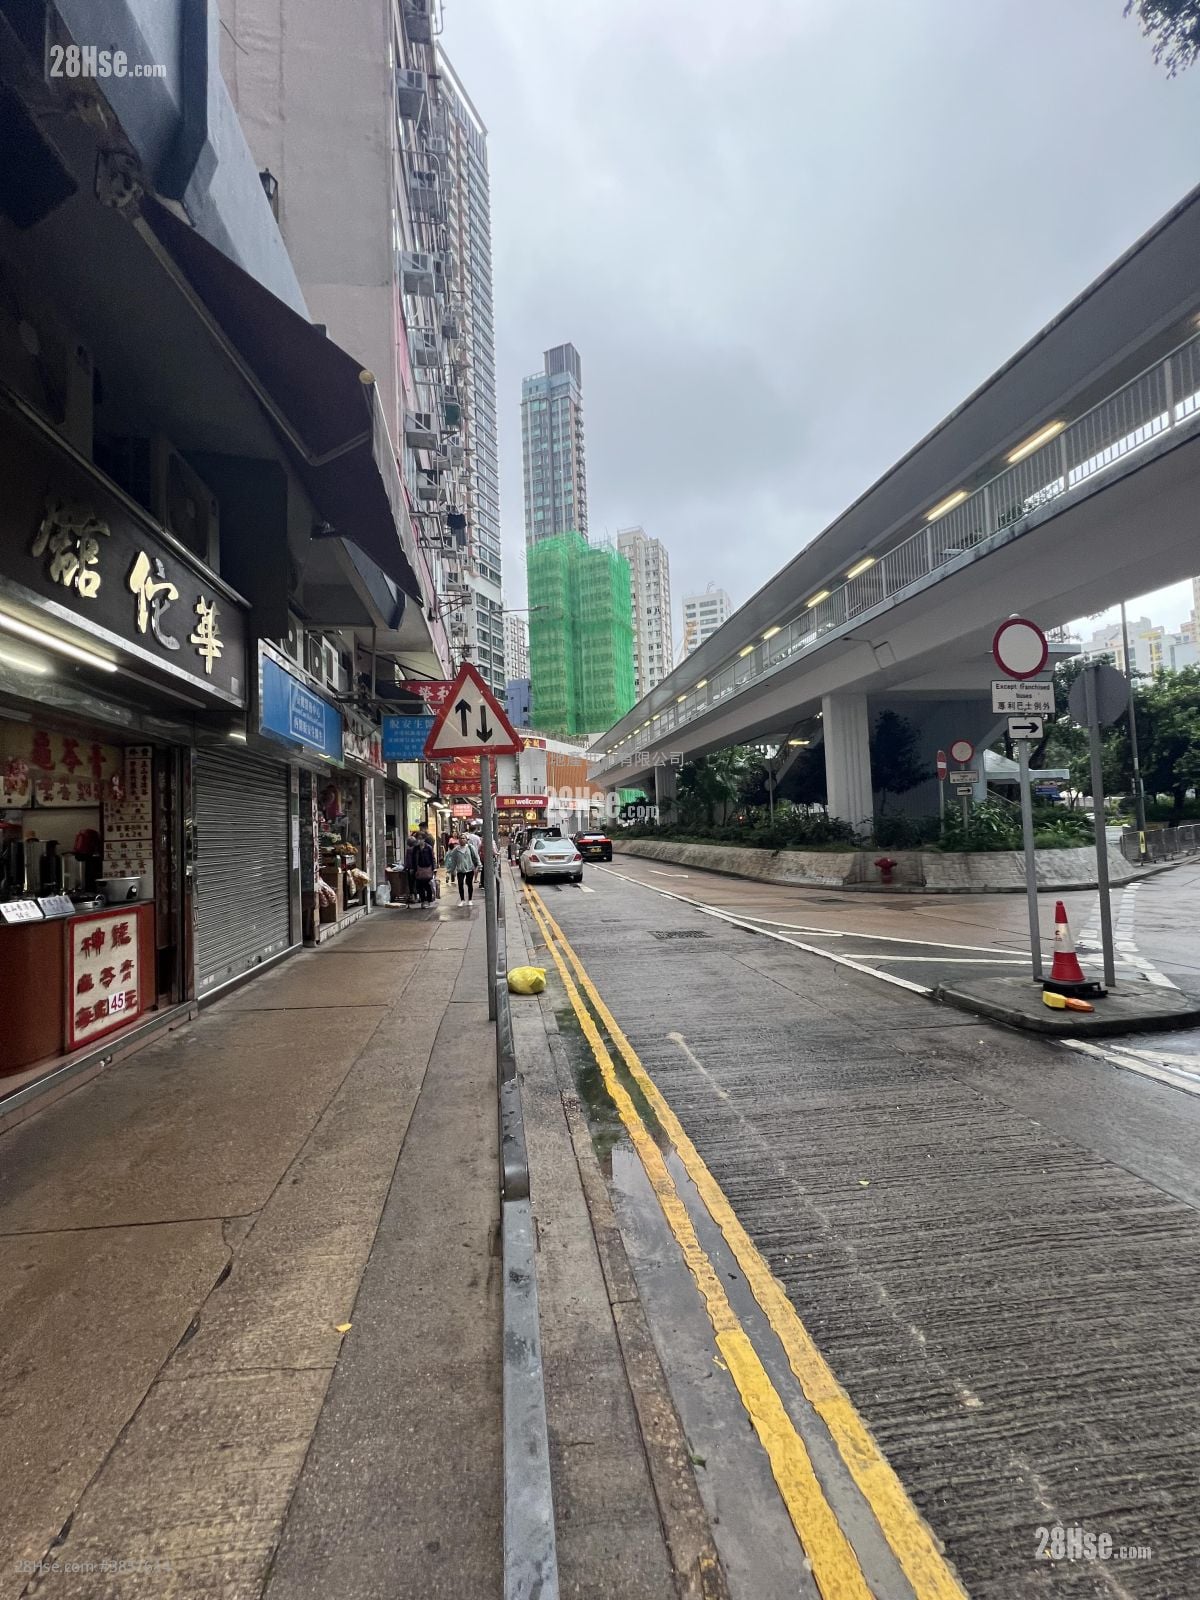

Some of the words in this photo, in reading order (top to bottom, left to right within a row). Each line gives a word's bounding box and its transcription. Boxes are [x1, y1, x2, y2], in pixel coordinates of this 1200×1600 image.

[997, 702, 1050, 710] 專利巴士例外
[111, 993, 124, 1011] 45
